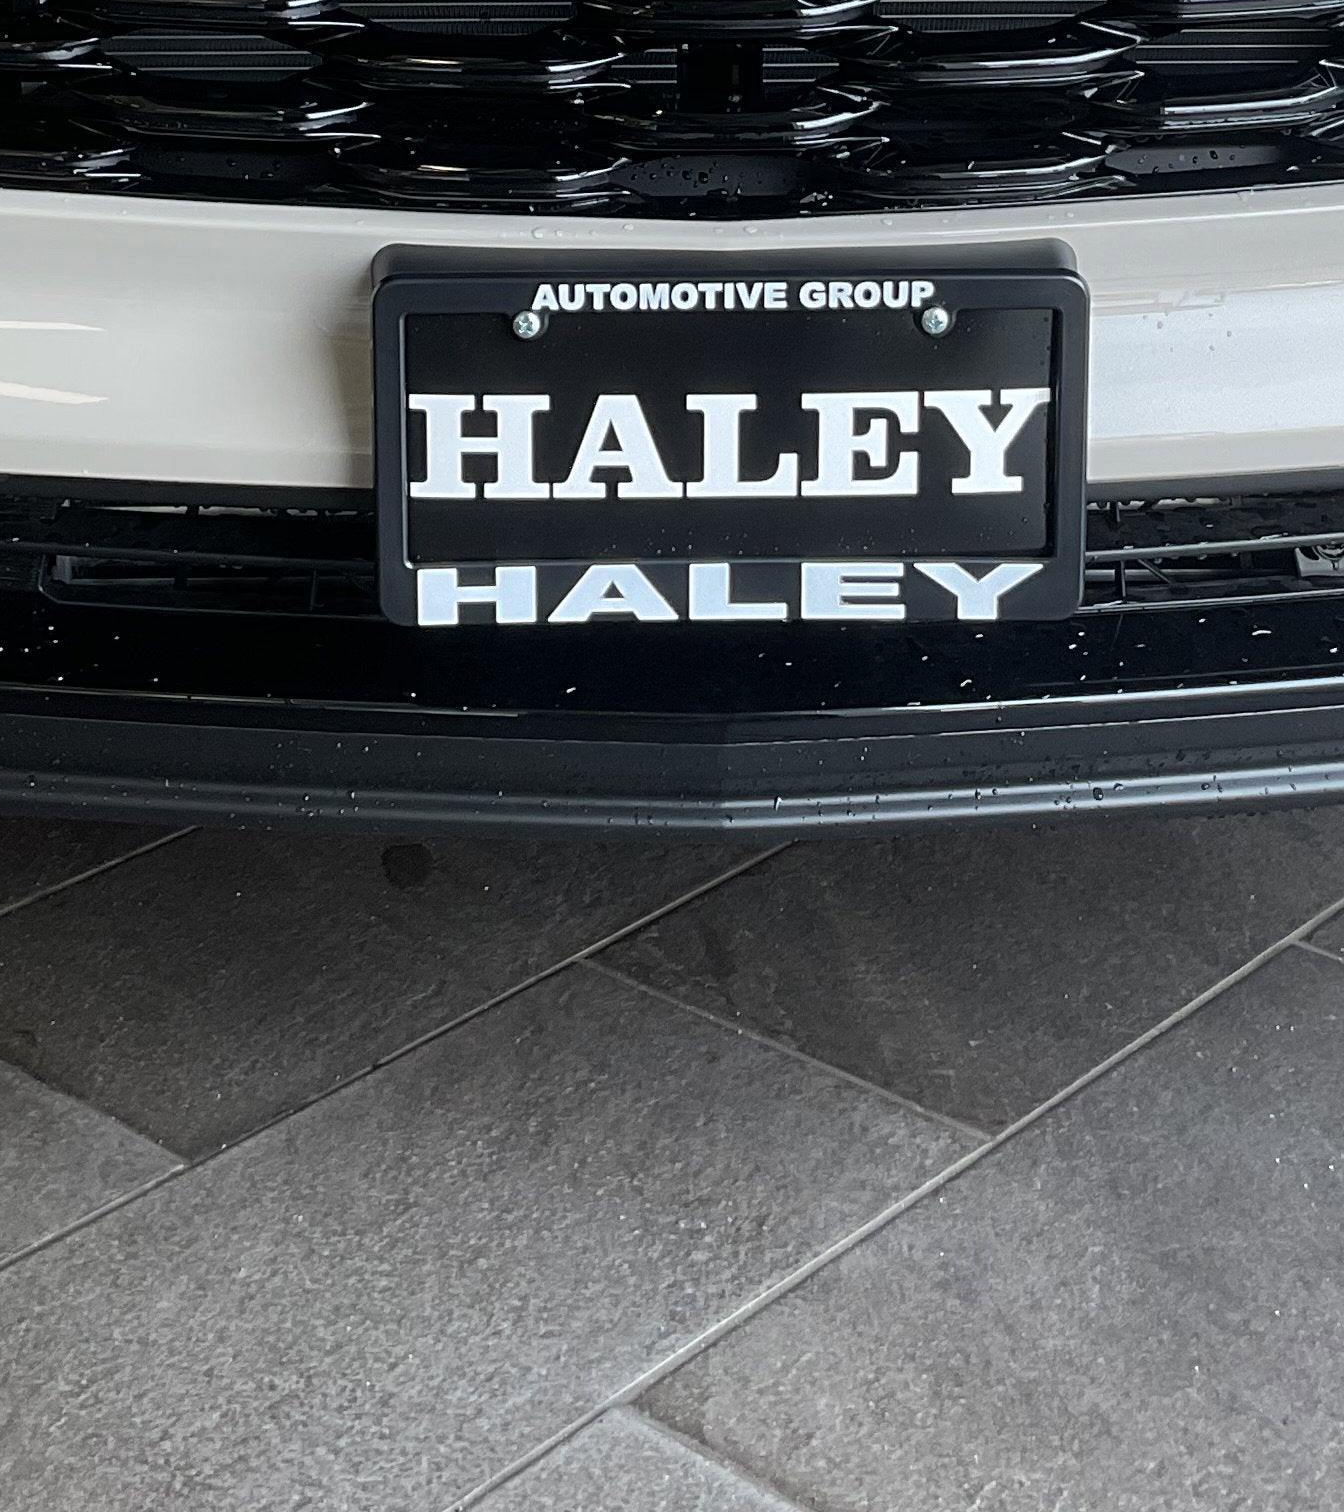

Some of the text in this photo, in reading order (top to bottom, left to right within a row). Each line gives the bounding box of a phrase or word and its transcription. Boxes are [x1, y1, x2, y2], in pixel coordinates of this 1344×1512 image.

[531, 280, 935, 312] AUTOMOTIVE GROUP
[407, 387, 1051, 499] HALEY
[415, 561, 1045, 626] HALEY
